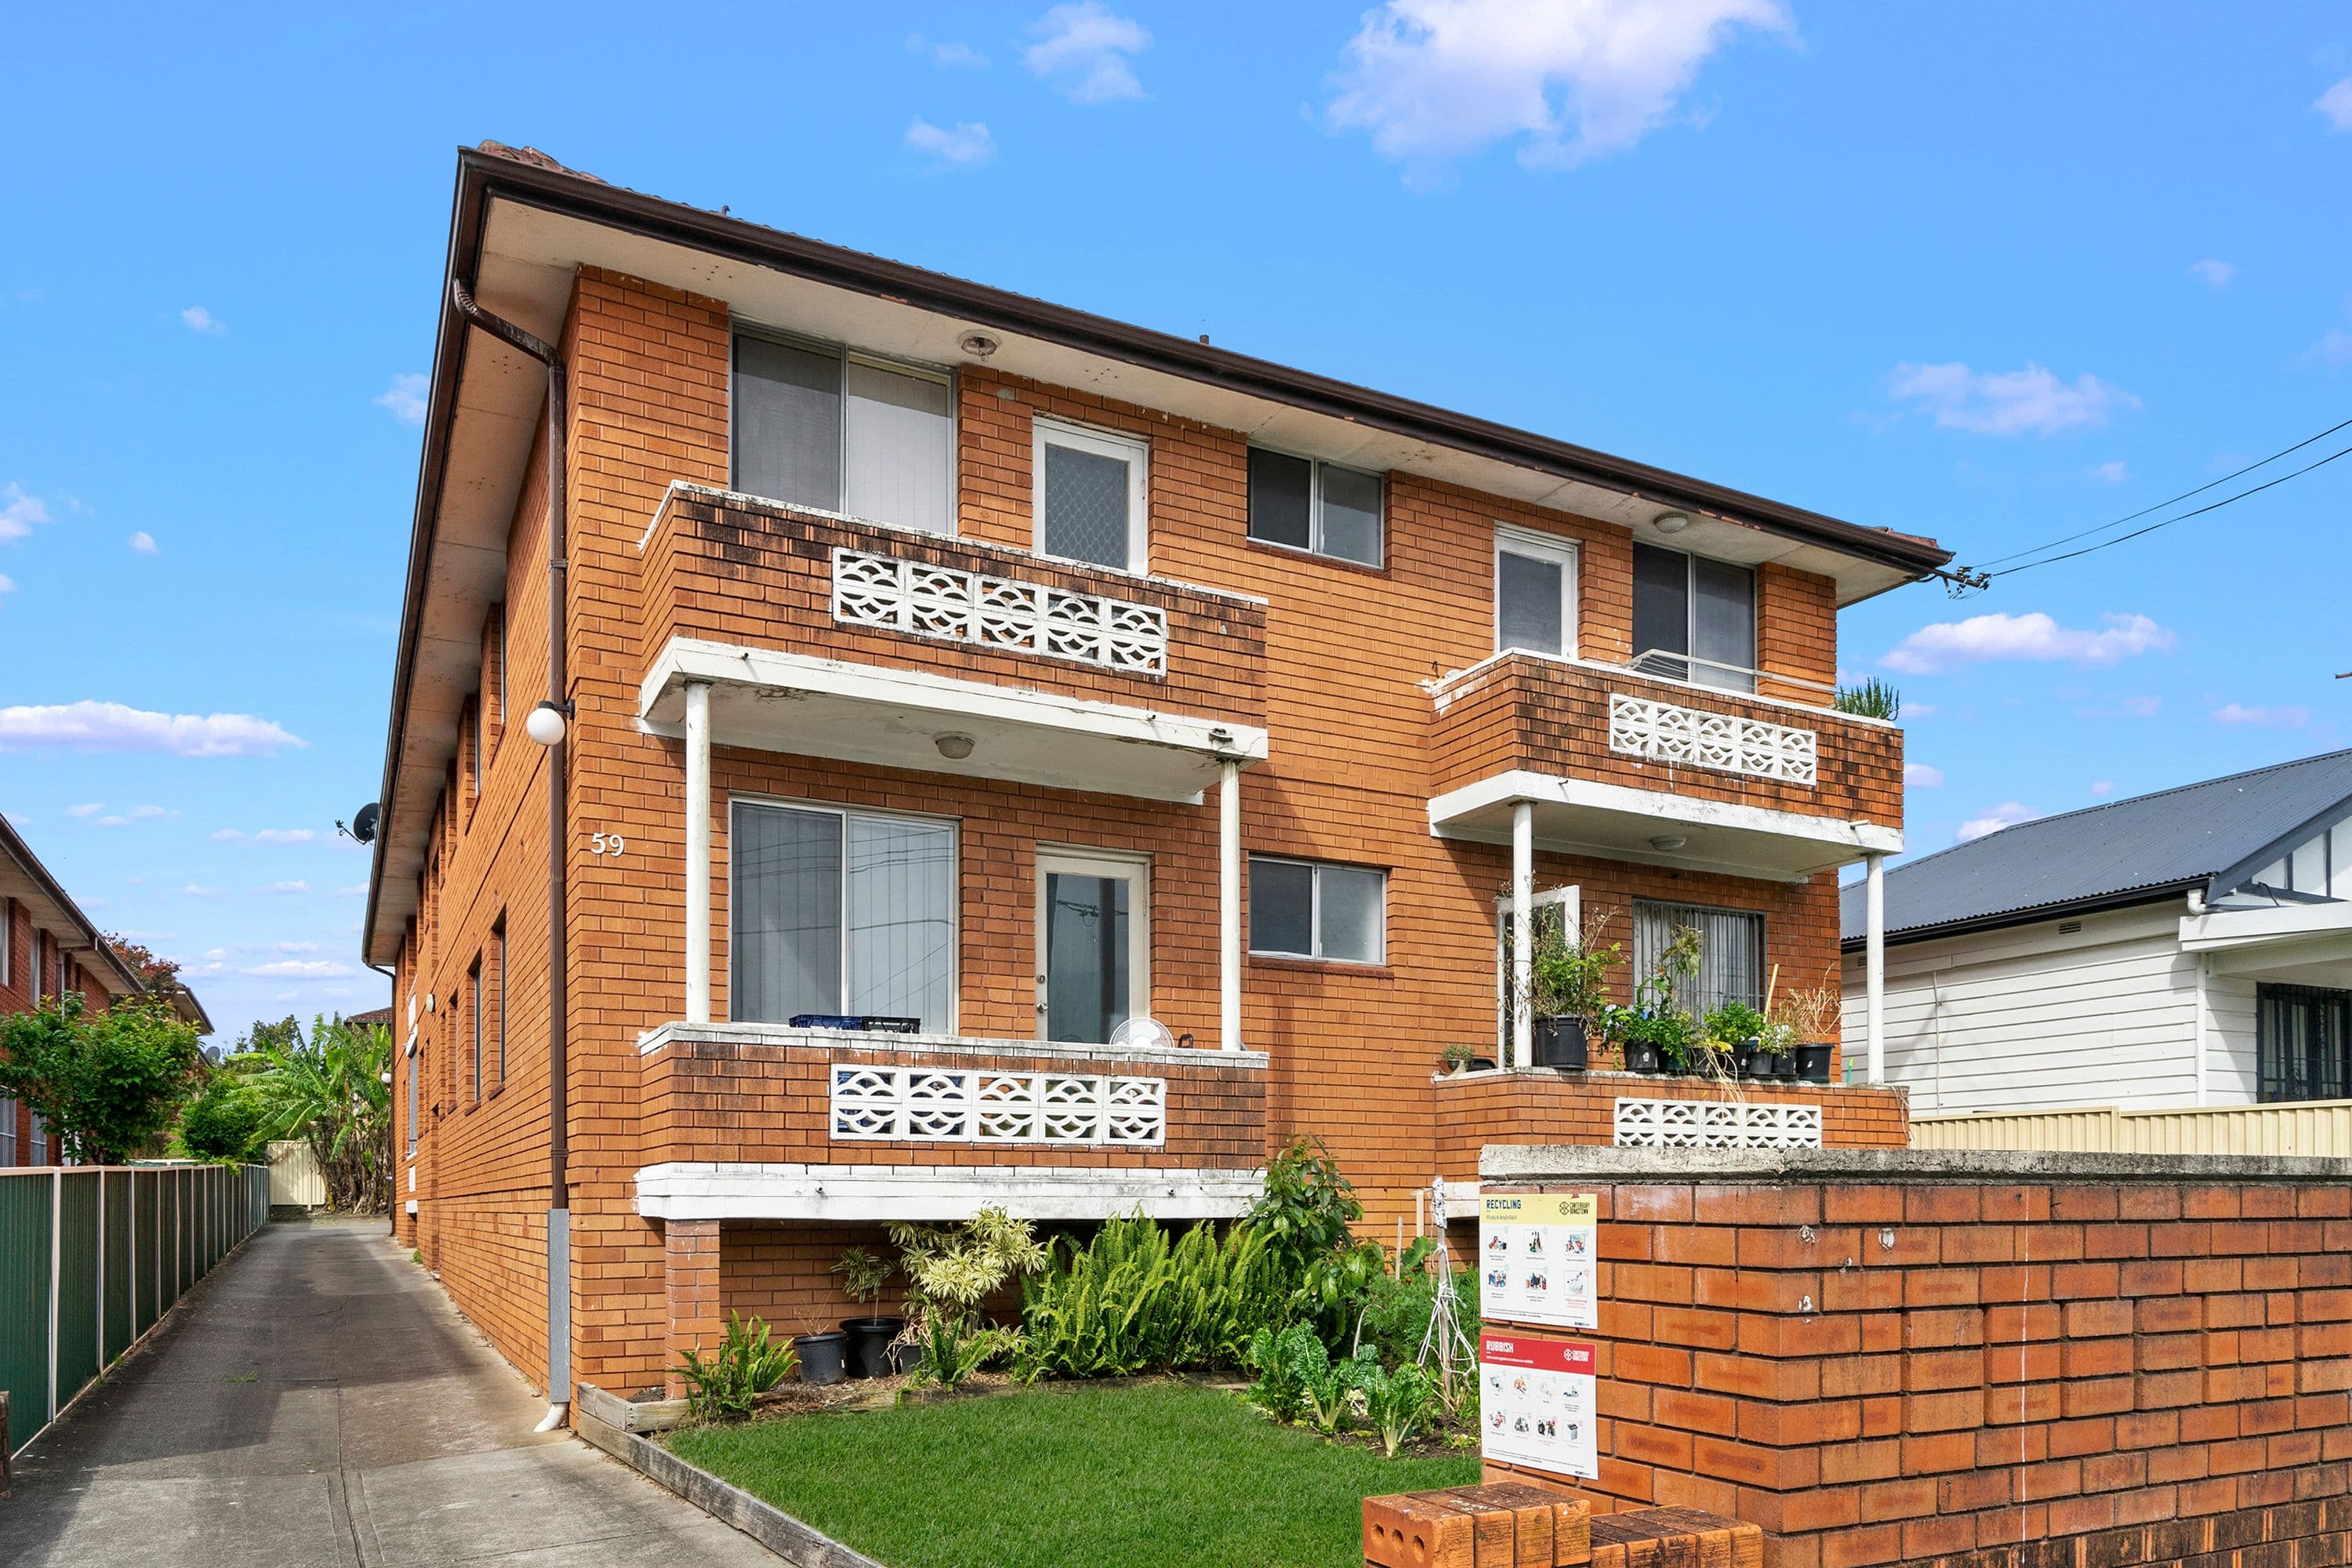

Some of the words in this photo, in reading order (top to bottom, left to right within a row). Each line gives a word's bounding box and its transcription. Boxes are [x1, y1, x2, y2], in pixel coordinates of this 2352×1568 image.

[590, 833, 625, 857] 59
[1486, 1200, 1521, 1209] RECYCLING
[1486, 1341, 1513, 1353] RUBBISH
